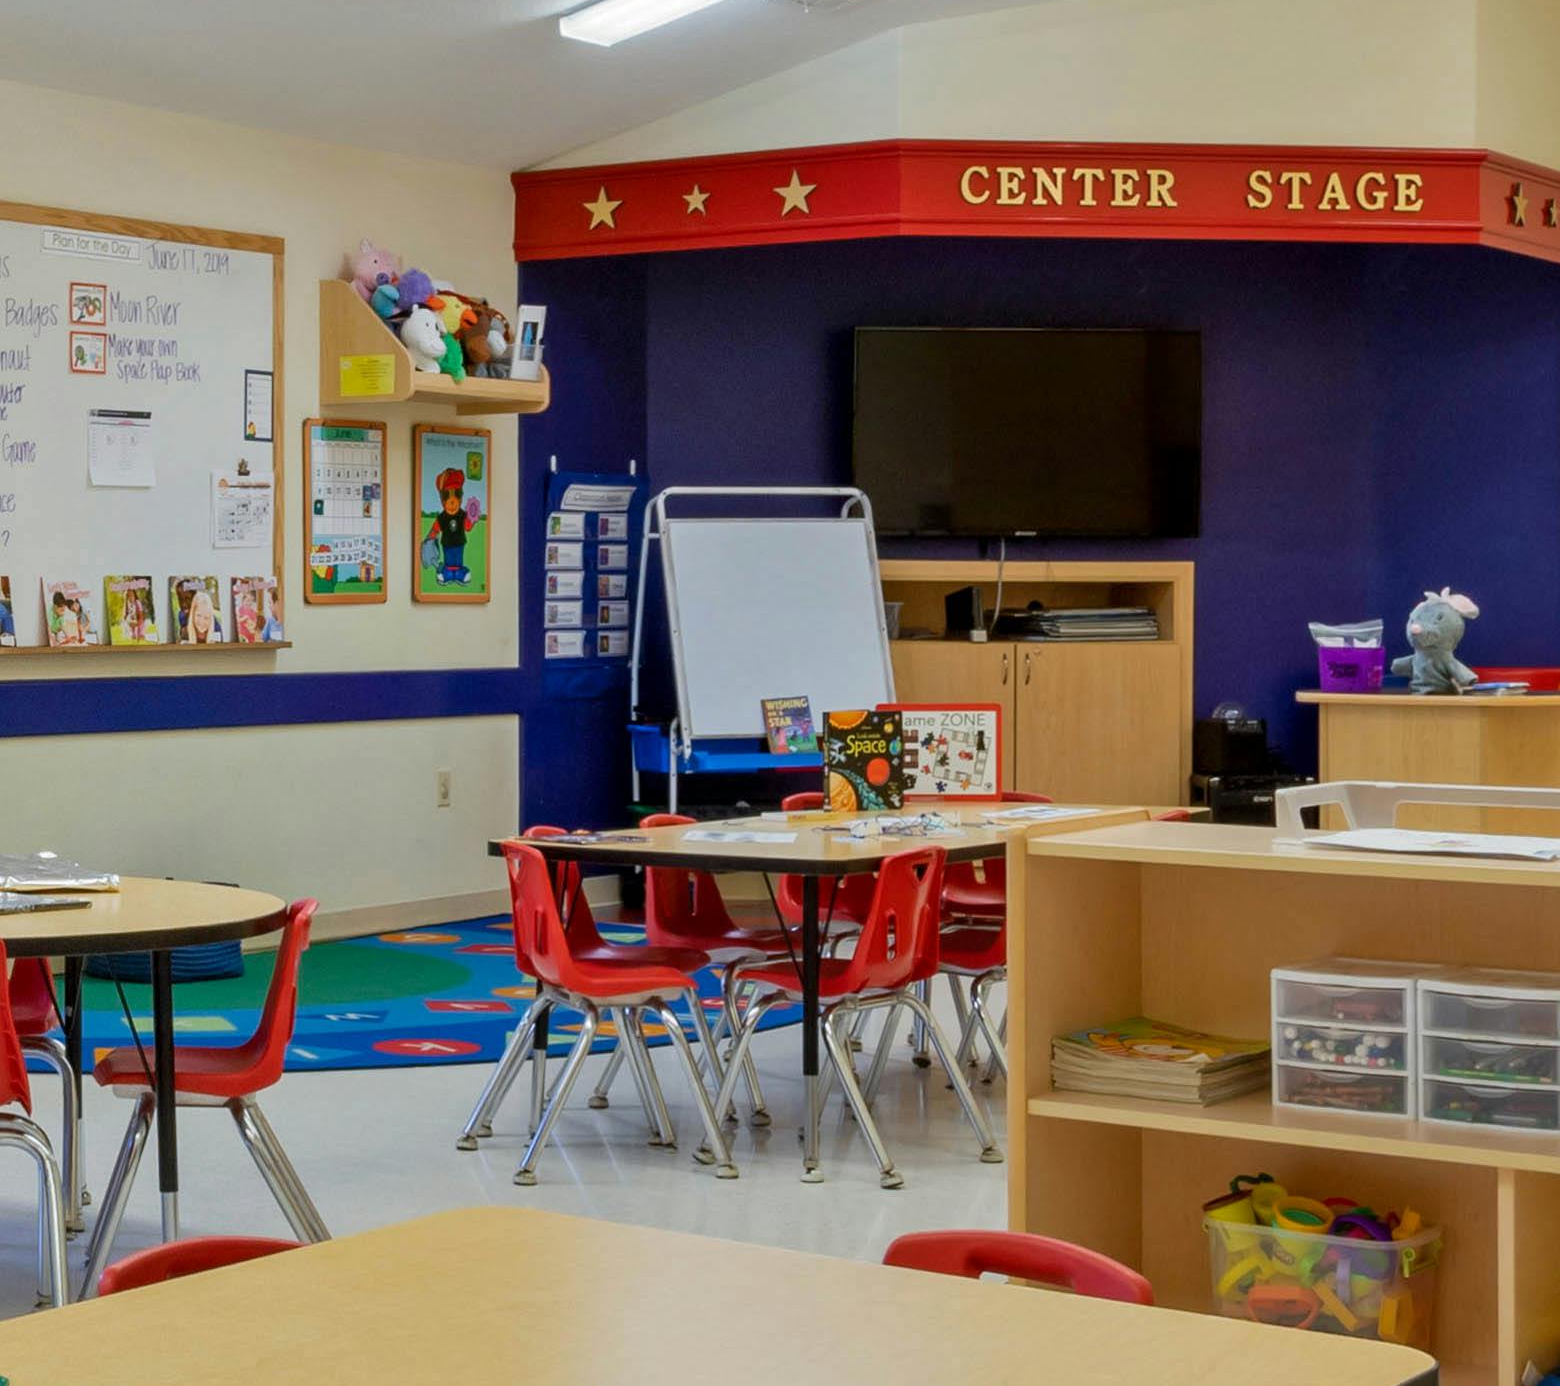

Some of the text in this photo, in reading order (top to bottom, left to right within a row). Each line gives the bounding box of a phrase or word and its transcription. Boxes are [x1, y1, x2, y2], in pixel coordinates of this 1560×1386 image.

[960, 165, 1425, 212] CENTER STAGE
[52, 233, 131, 257] Plan for the Day
[147, 243, 178, 270] June
[204, 251, 230, 275] 2019
[5, 297, 59, 338] Badges
[110, 291, 181, 326] Moon River
[108, 333, 178, 361] Make your own
[176, 363, 201, 382] Book
[2, 433, 37, 468] Game
[765, 698, 808, 710] WISHING
[768, 717, 793, 728] STAR
[903, 713, 986, 727] ame ZONE
[846, 734, 887, 758] Space
